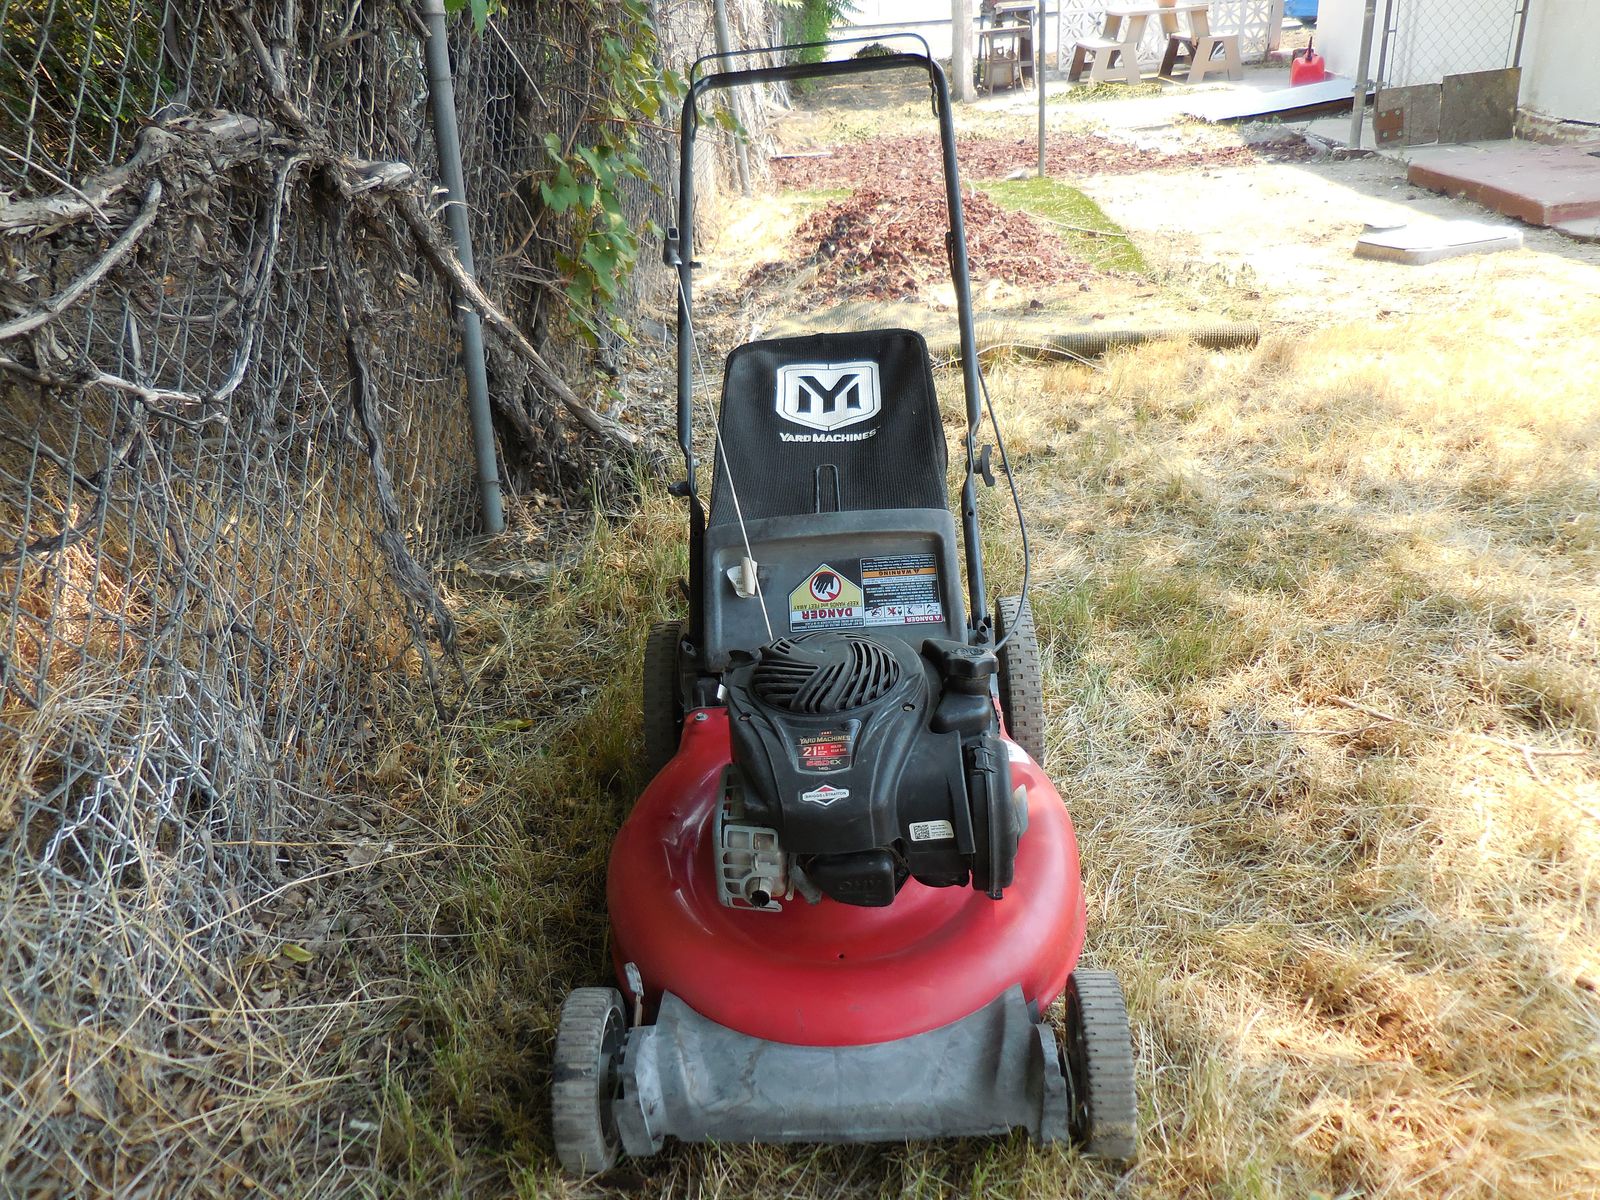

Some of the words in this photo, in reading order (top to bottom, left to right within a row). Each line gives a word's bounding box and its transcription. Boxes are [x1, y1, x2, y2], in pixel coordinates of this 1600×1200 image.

[780, 432, 812, 442] YARD
[812, 429, 878, 443] MACHINES
[801, 607, 853, 620] DANGER
[906, 615, 934, 623] DANGER
